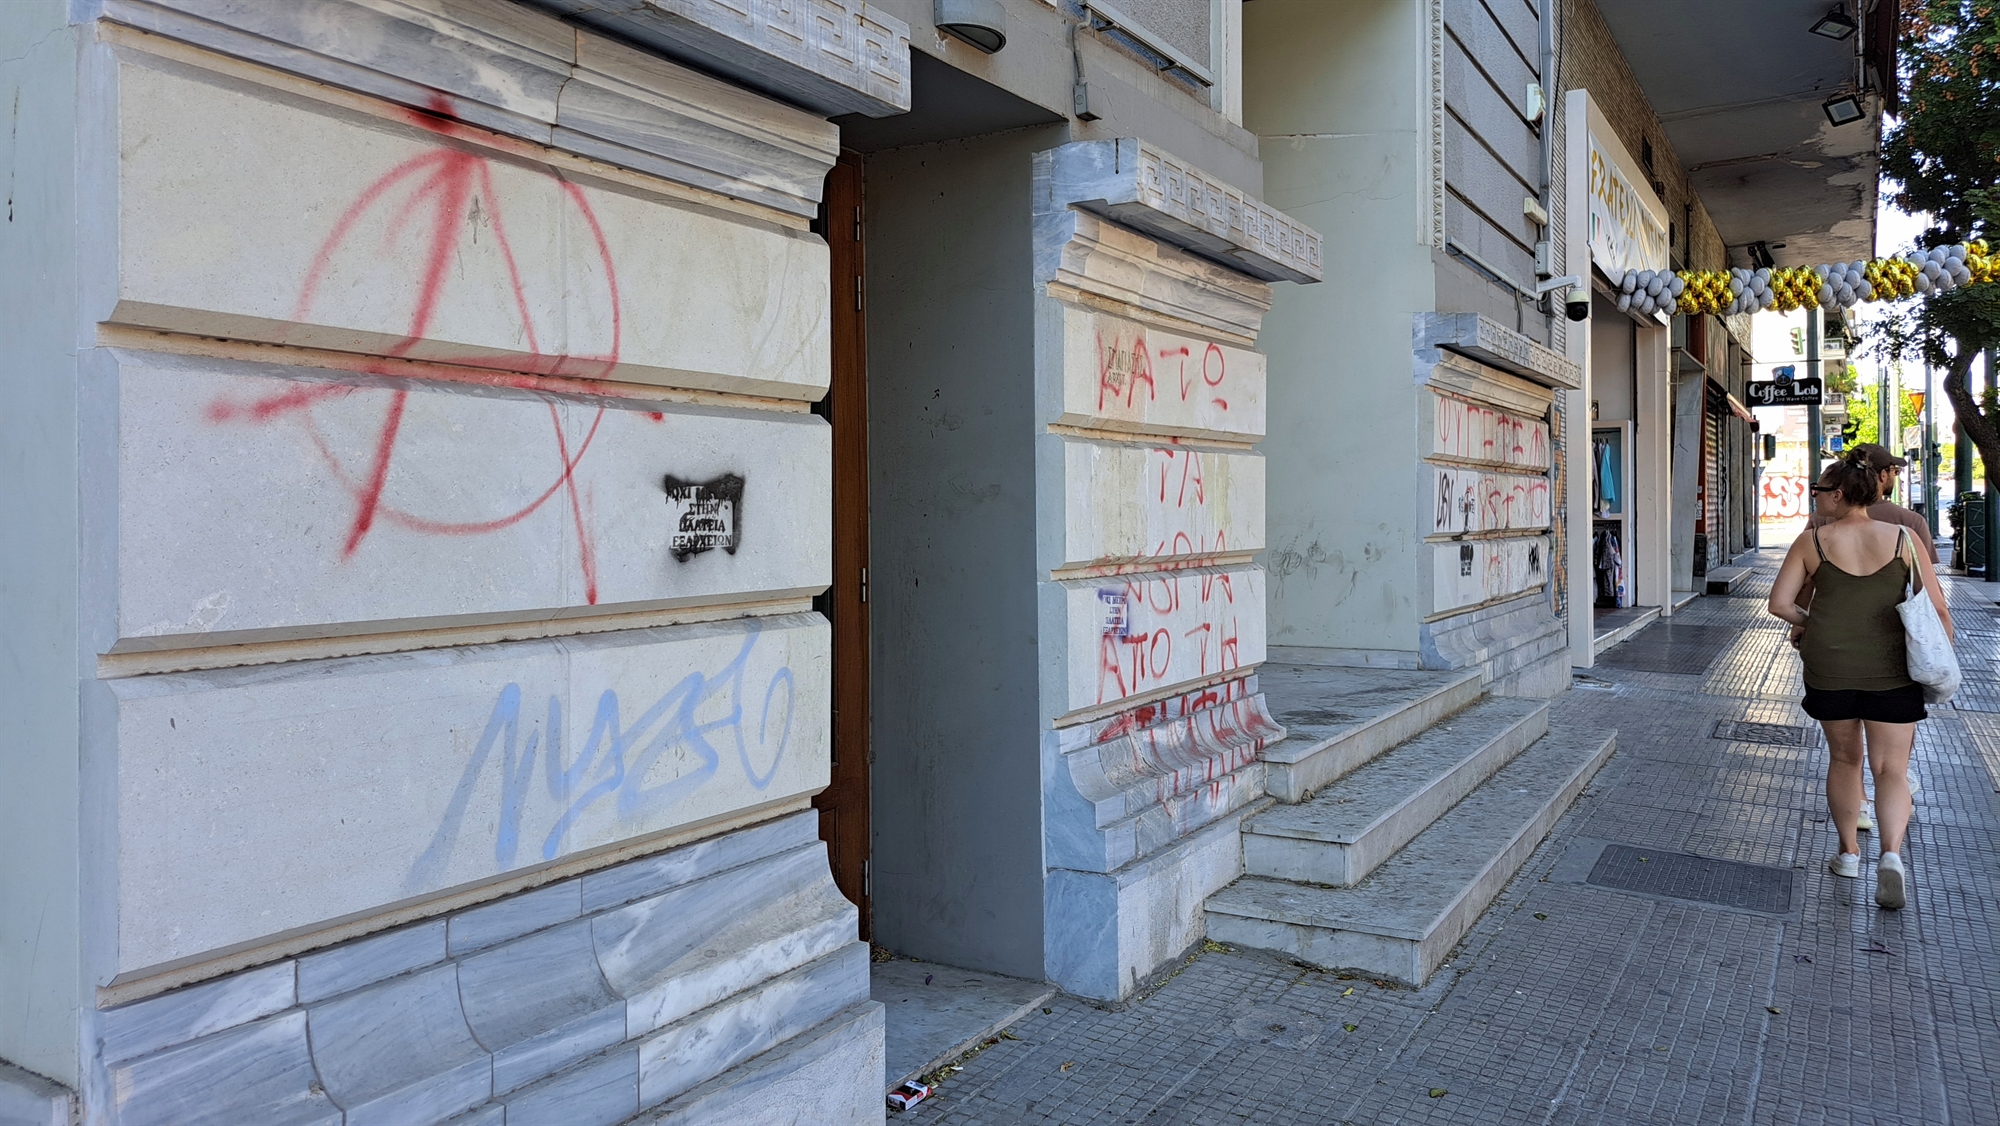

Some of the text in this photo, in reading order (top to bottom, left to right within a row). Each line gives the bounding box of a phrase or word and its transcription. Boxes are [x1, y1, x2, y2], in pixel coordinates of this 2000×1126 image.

[1749, 383, 1788, 405] Coffee
[689, 504, 718, 515] ΣΤΗΝ
[673, 535, 731, 547] ΕΞΑΡΧΕΙΩΝ
